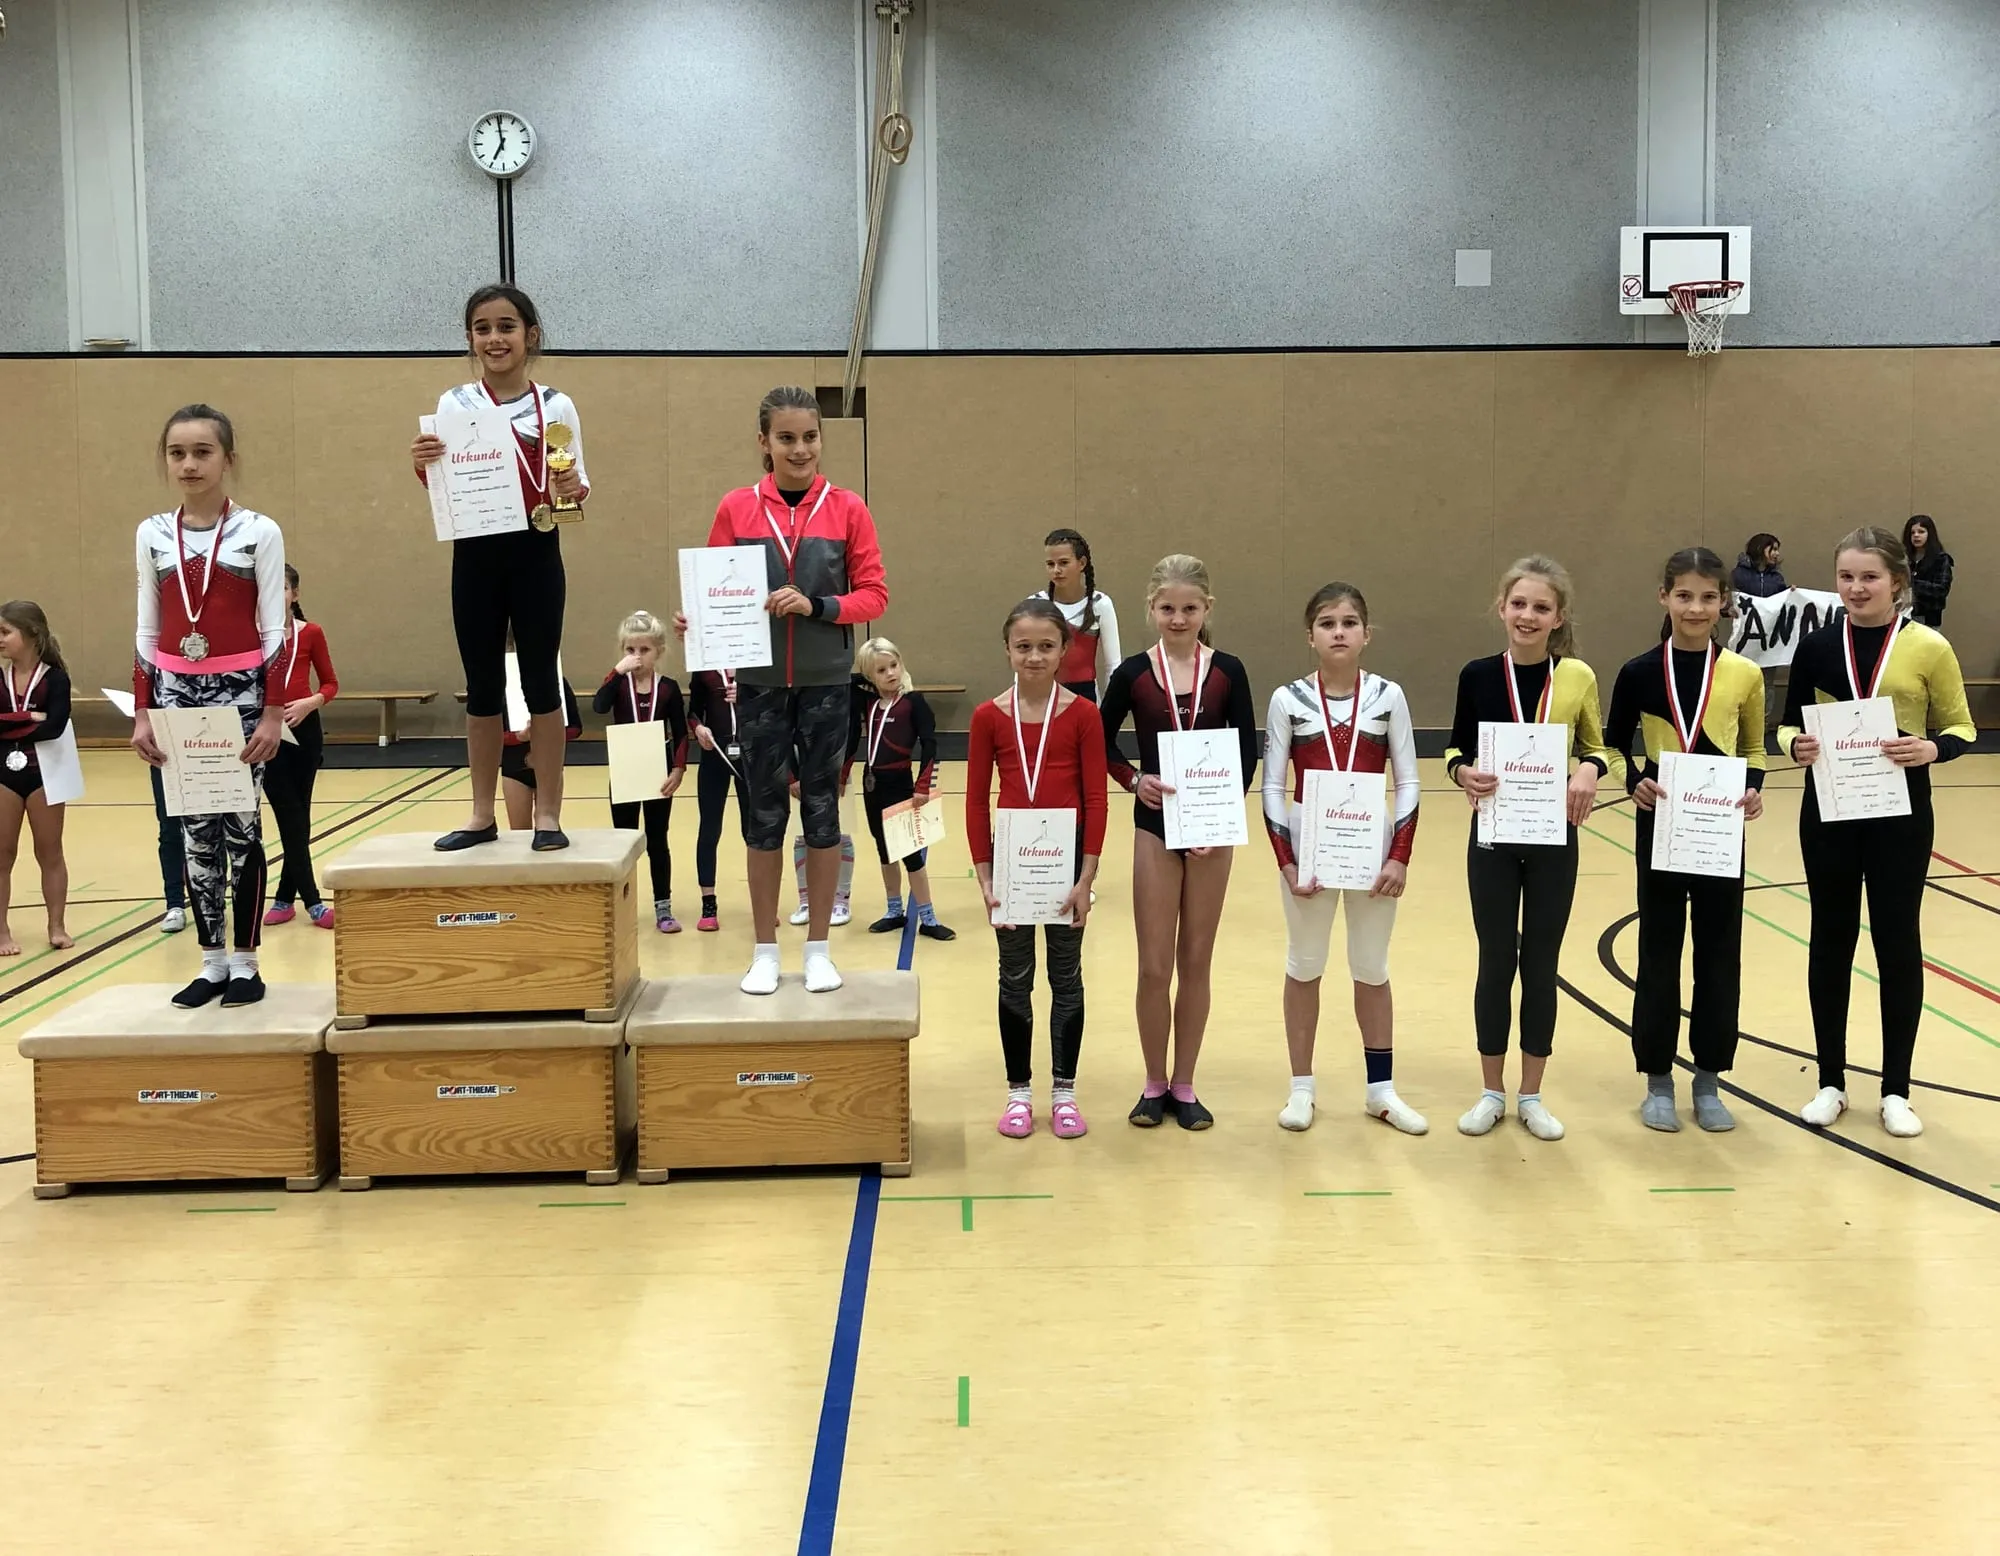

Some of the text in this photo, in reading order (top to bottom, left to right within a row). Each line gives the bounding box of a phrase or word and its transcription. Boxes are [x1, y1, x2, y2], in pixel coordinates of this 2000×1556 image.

[451, 448, 503, 464] Urkunde
[708, 585, 756, 597] Urkunde
[184, 739, 234, 749] Urkunde
[1835, 737, 1886, 750] Urkunde
[1185, 767, 1231, 779] Urkunde
[1504, 761, 1555, 774] Urkunde
[1683, 791, 1733, 807] Urkunde
[1325, 808, 1372, 822] Urkunde
[1018, 846, 1064, 857] Urkunde
